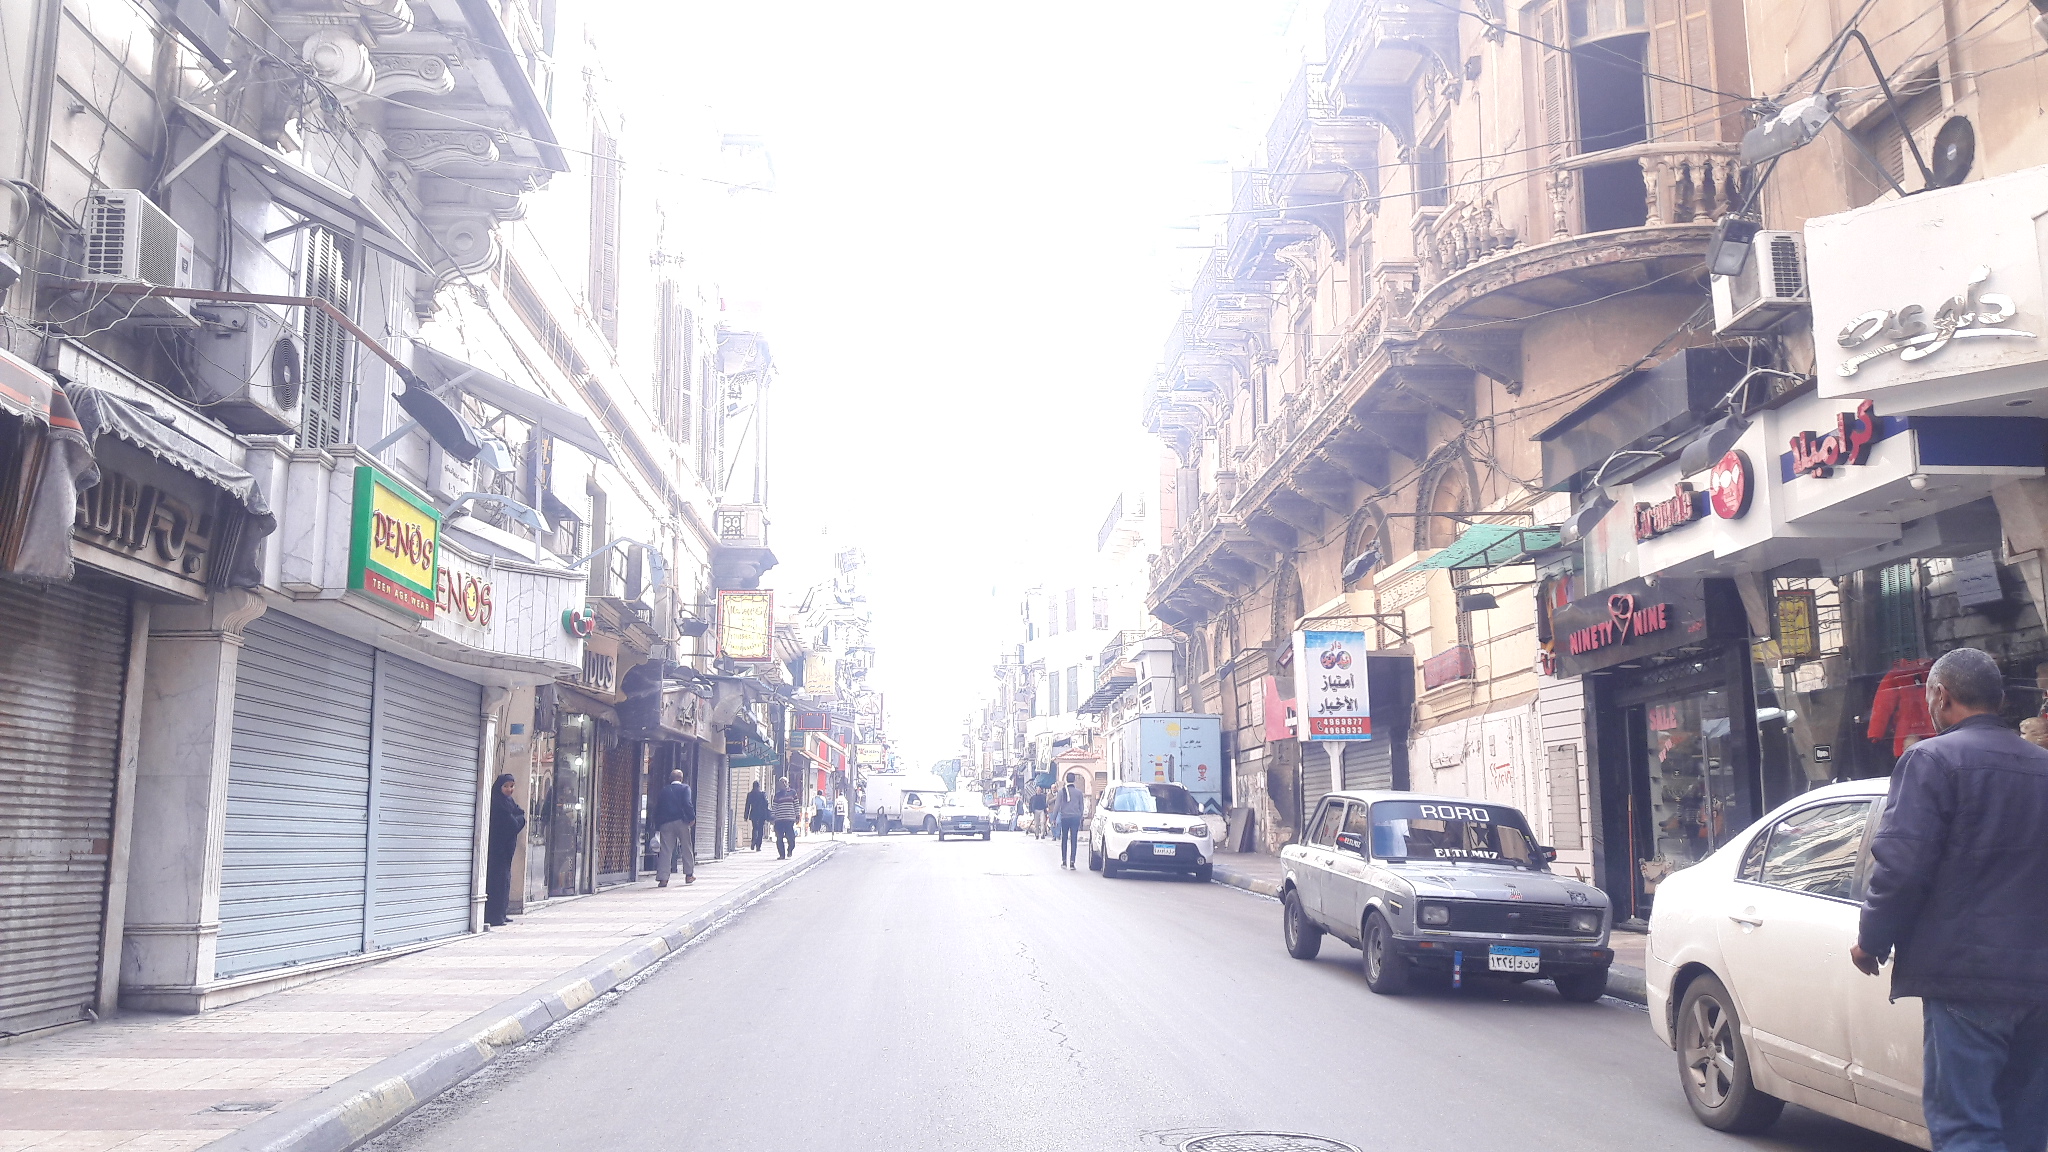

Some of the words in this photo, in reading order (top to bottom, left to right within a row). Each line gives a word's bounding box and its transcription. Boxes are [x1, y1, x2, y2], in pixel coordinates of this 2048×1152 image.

[1788, 399, 1874, 479] كراميلا
[373, 509, 434, 571] DENOS
[372, 578, 392, 594] TEEN
[394, 589, 409, 602] AGE
[411, 596, 431, 613] WEAR
[435, 566, 493, 627] ENOS
[1569, 619, 1614, 656] NINETY
[1633, 602, 1668, 637] NINE
[1317, 695, 1359, 715] الأخبار
[1649, 705, 1677, 731] SALE
[1420, 804, 1490, 822] RORO
